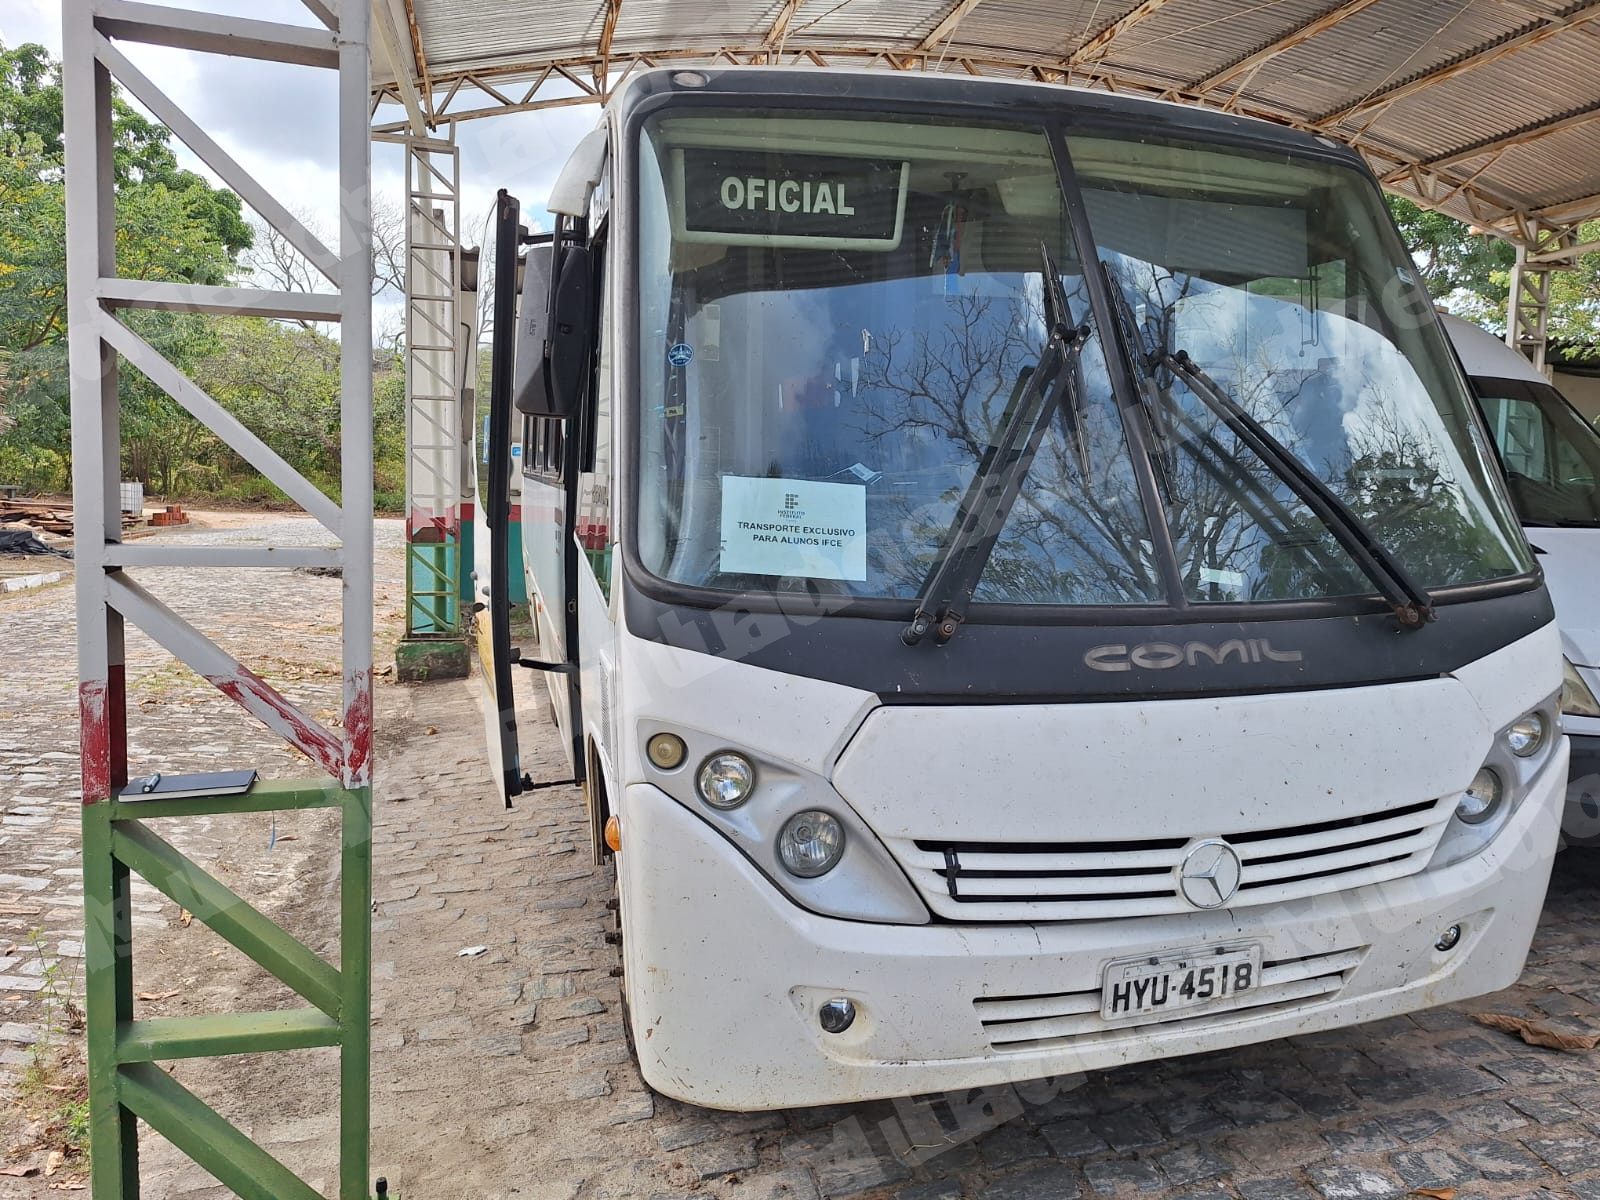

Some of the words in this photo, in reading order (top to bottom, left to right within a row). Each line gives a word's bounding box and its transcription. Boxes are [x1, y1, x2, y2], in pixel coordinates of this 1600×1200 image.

[720, 176, 855, 216] OFICIAL
[737, 521, 801, 533] TRANSPORTE
[803, 526, 856, 537] EXCLUSIVO
[753, 534, 778, 543] PARA
[780, 536, 819, 546] ALUNOS
[821, 539, 843, 547] IFCE
[1084, 638, 1303, 672] COMIL
